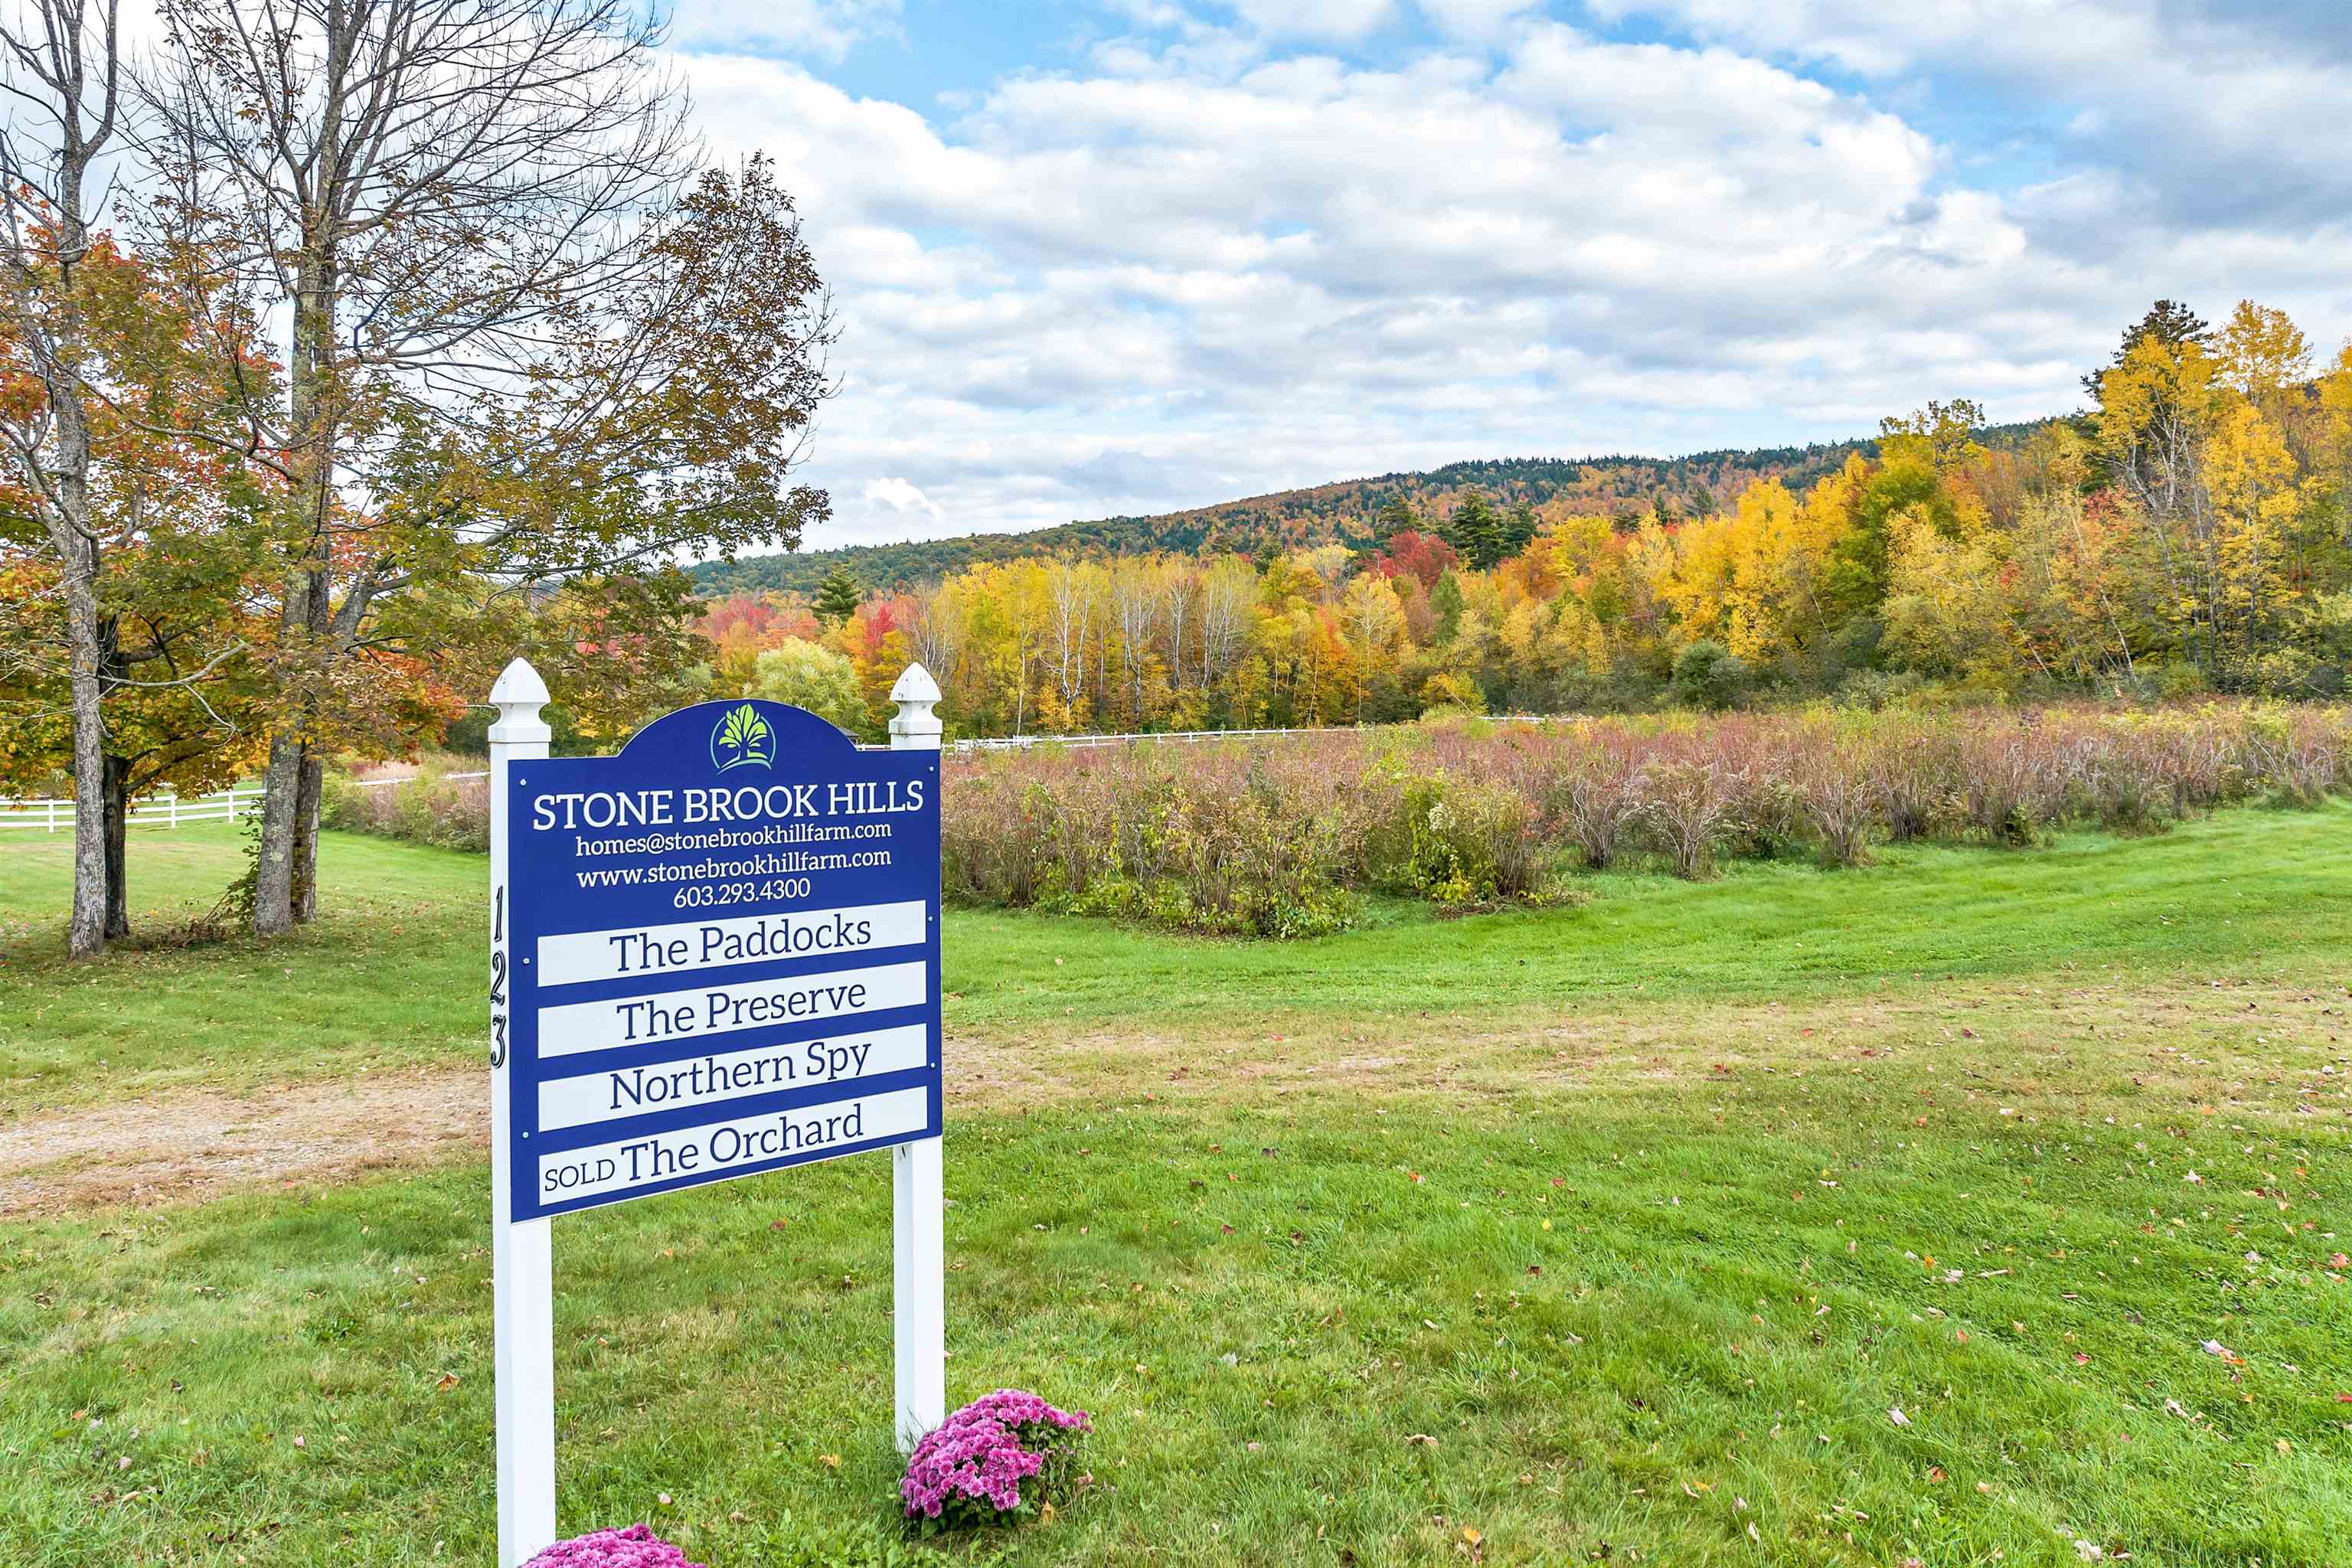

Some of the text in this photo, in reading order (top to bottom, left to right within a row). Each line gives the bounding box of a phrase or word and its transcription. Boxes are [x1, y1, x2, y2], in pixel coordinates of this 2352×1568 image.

[533, 781, 924, 831] STONE BROOK HILLS
[576, 822, 891, 857] homes@stonebrookhillfarm.com
[577, 848, 891, 888] www.stonebrookhillfarm.com
[674, 879, 810, 908] 603.293.4300
[609, 913, 871, 972] The Paddocks
[617, 982, 866, 1040] The Preserve
[610, 1042, 871, 1109] Northern Spy
[544, 1104, 862, 1191] SOLD The Orchard
